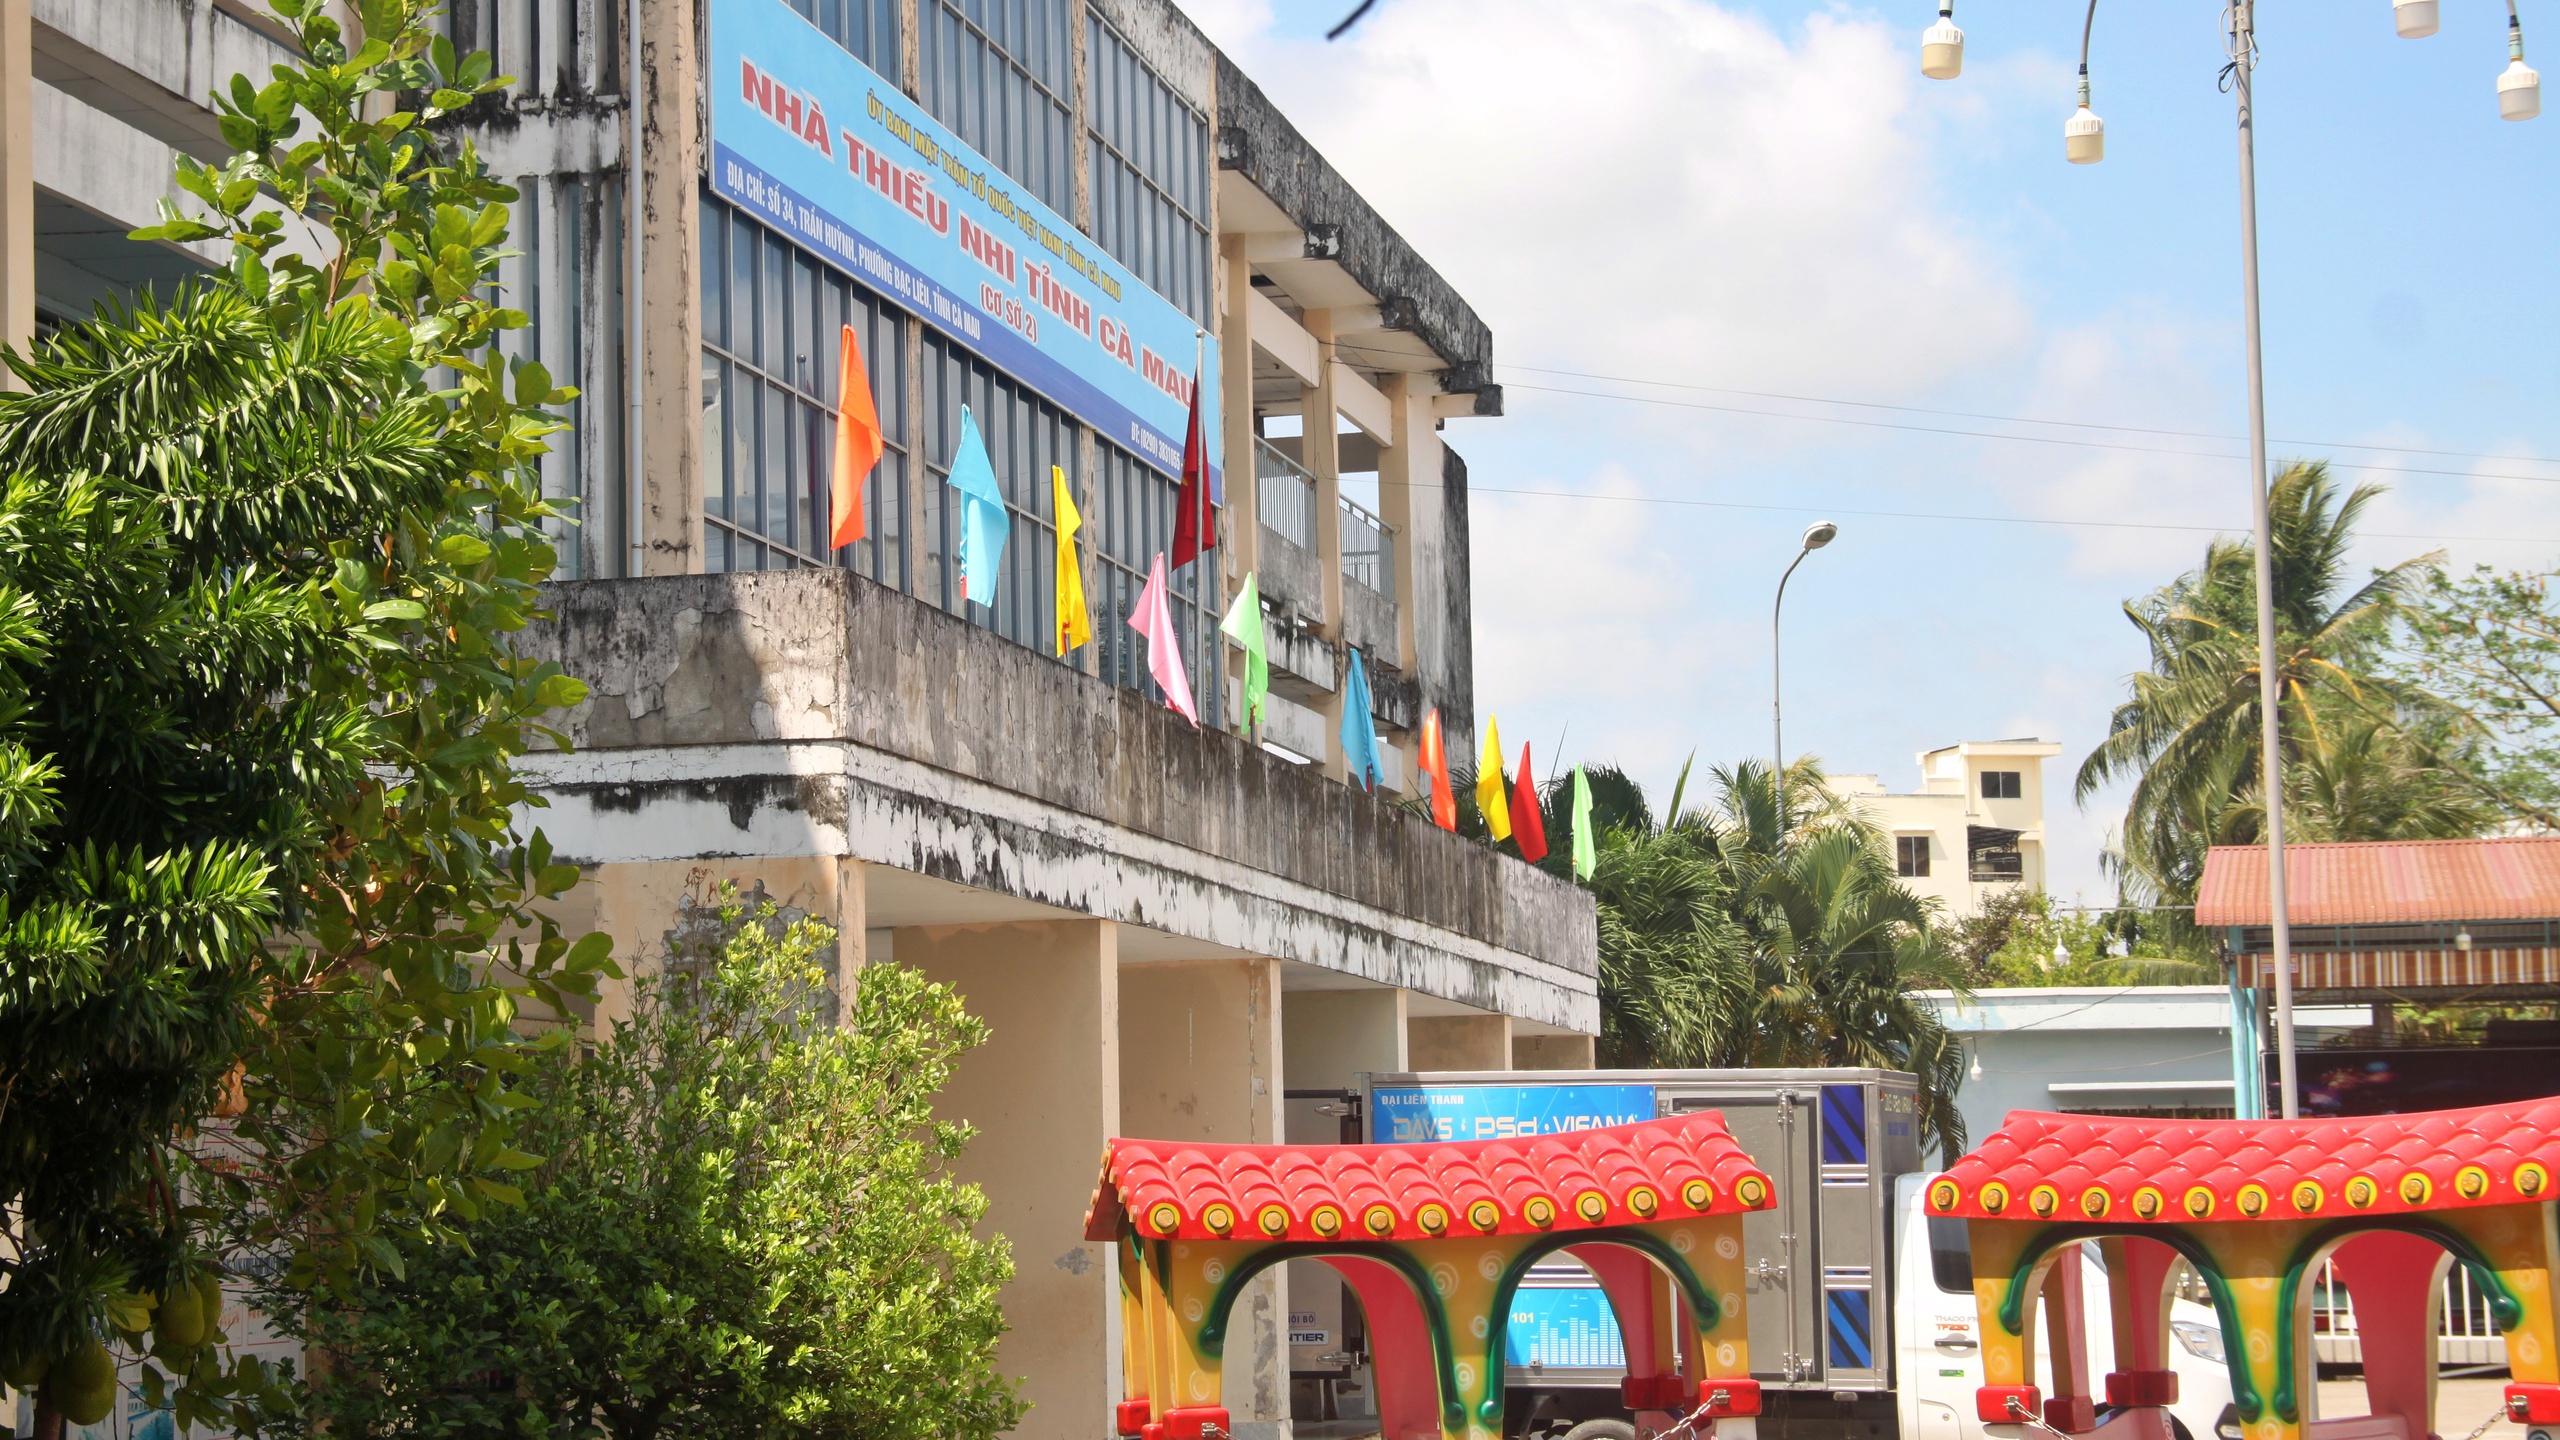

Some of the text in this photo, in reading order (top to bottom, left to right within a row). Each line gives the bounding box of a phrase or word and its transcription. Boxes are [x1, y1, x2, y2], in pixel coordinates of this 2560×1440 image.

[867, 88, 1121, 303] ỦY BAN MẶT TRẬN TỔ QUỐC VIỆT NAM TỈNH CÀ MAU
[727, 160, 981, 341] ĐỊA CHỈ: SỐ 34, TRẦN HUỲNH, PHƯỜNG BẠC LIÊU, TỈNH CÀ MAU
[741, 54, 1195, 410] NHÀ THIẾU NHI TỈNH CÀ MAU
[981, 284, 1037, 343] (CƠ SỞ 2)
[1382, 1094, 1464, 1106] ĐẠI LIÊN THANH
[1393, 1117, 1453, 1140] DAVS
[1511, 1312, 1535, 1324] 101
